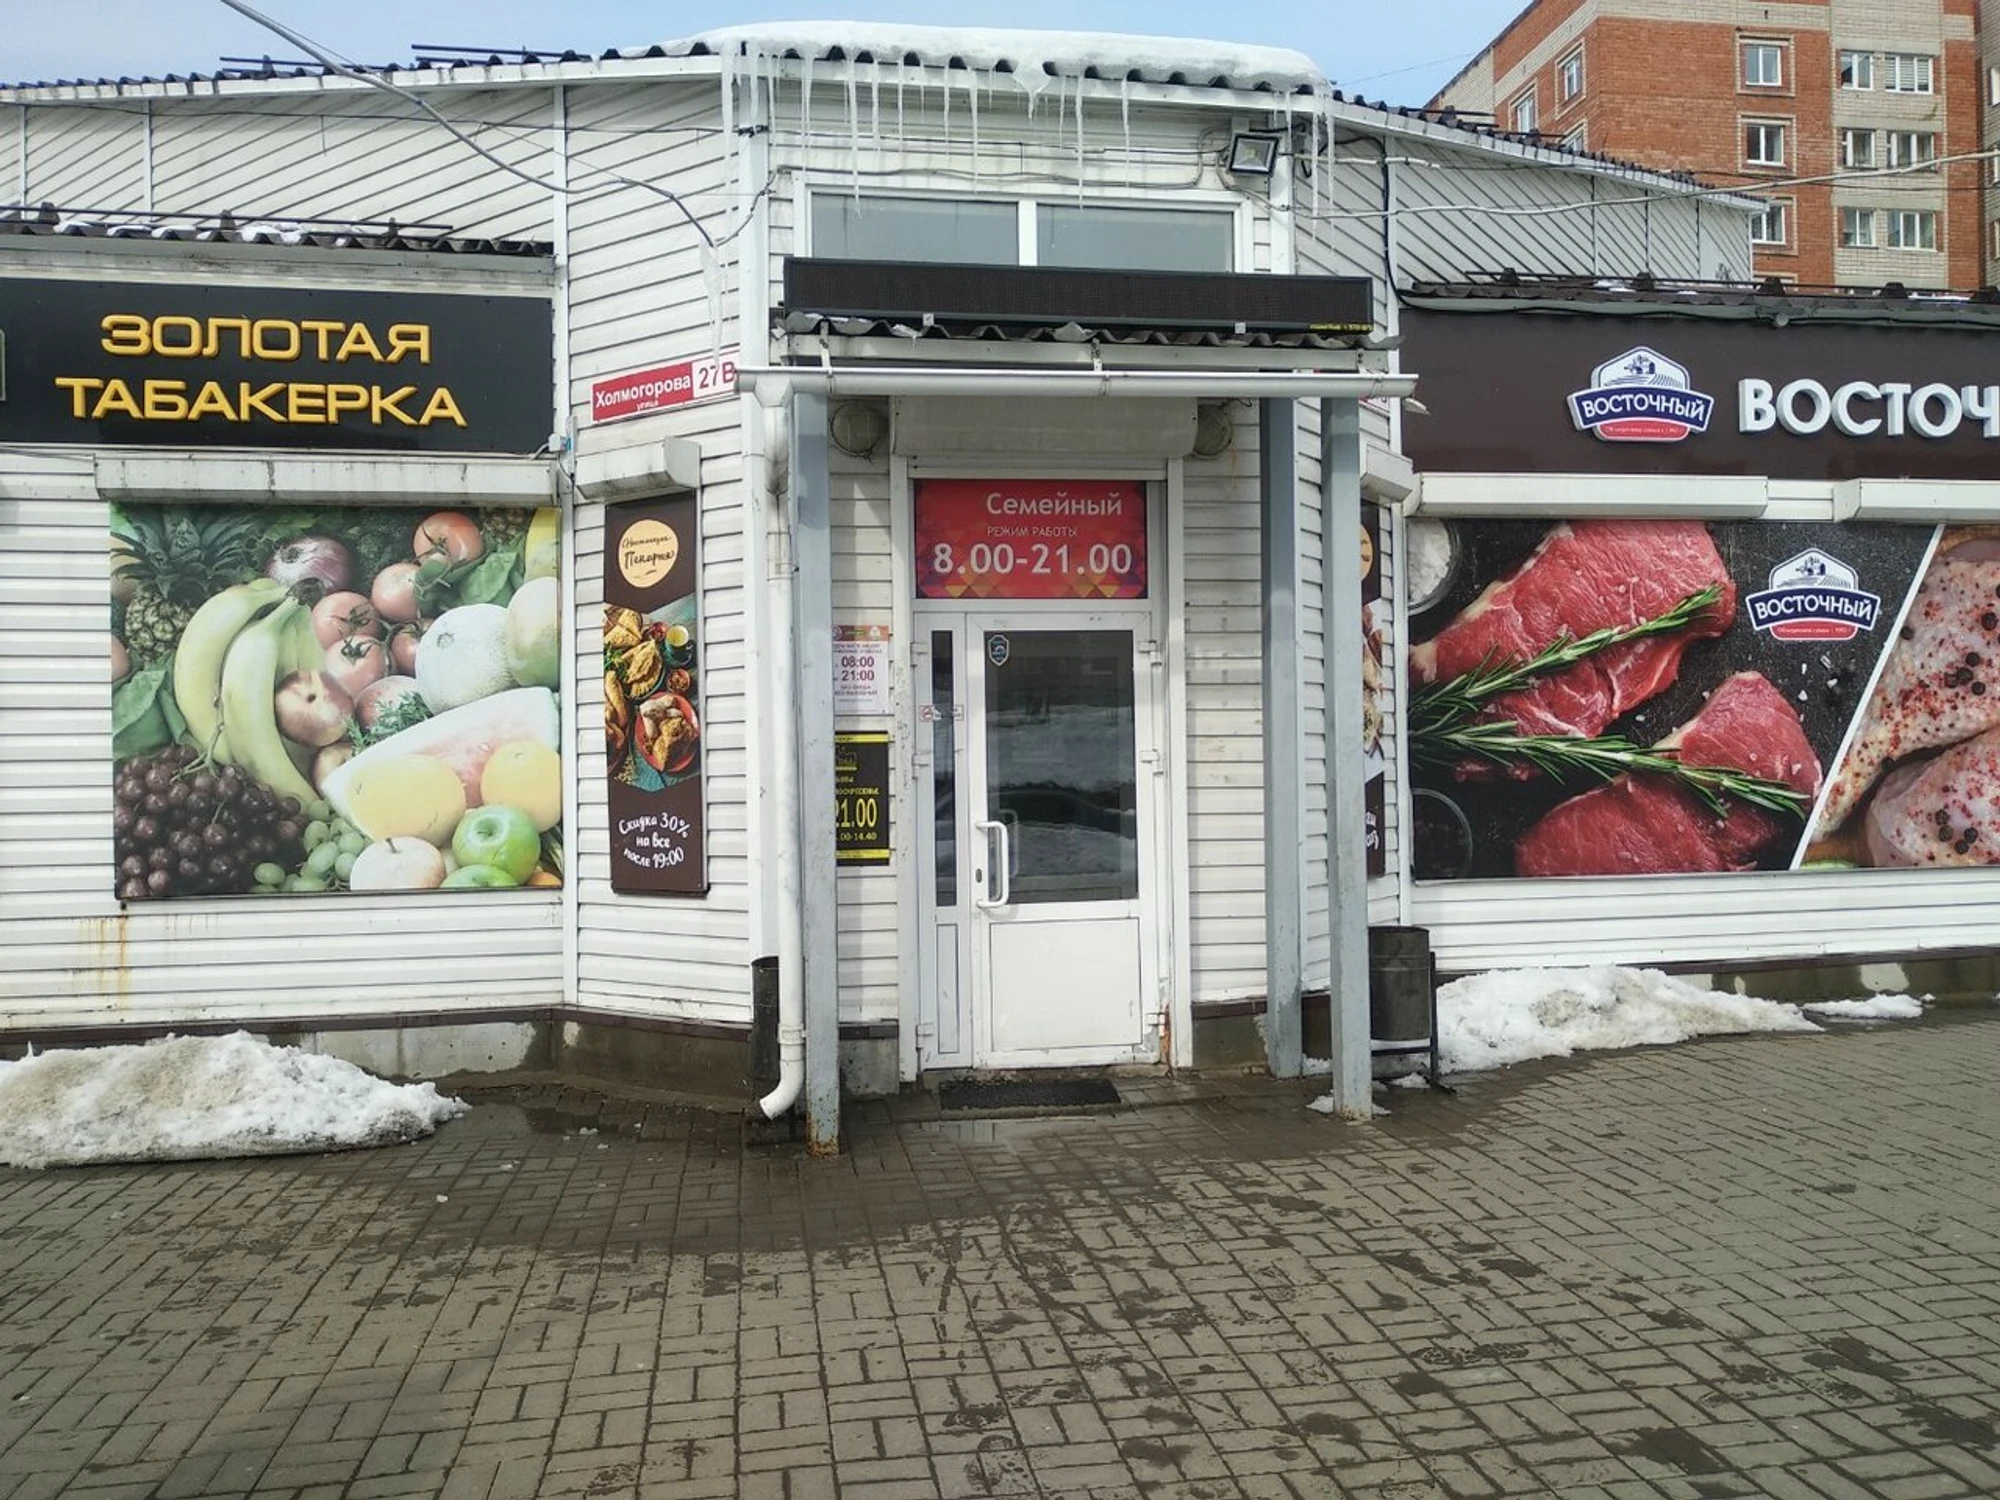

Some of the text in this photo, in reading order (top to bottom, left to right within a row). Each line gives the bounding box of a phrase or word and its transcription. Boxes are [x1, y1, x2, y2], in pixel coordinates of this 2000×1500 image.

[101, 313, 431, 365] ЗОЛОТАЯ
[54, 376, 468, 428] ТАБАКЕРКА
[595, 374, 692, 408] Холмогорова
[636, 399, 660, 412] улица
[1581, 393, 1706, 422] ВОСТОЧНЫЙ
[1738, 377, 2000, 438] ВОСТОЧ
[986, 491, 1122, 516] Семейный
[987, 526, 1078, 538] РЕЖИМ РАБОТЫ
[623, 550, 675, 569] Пекарня
[933, 542, 1133, 575] 8.00-21.00
[1755, 594, 1873, 622] ВОСТОЧНЫЙ
[841, 655, 875, 668] 08:00
[841, 670, 875, 681] 21:00
[618, 812, 691, 839] Скидка 30%
[635, 832, 671, 848] на все
[623, 846, 684, 869] после 19:00
